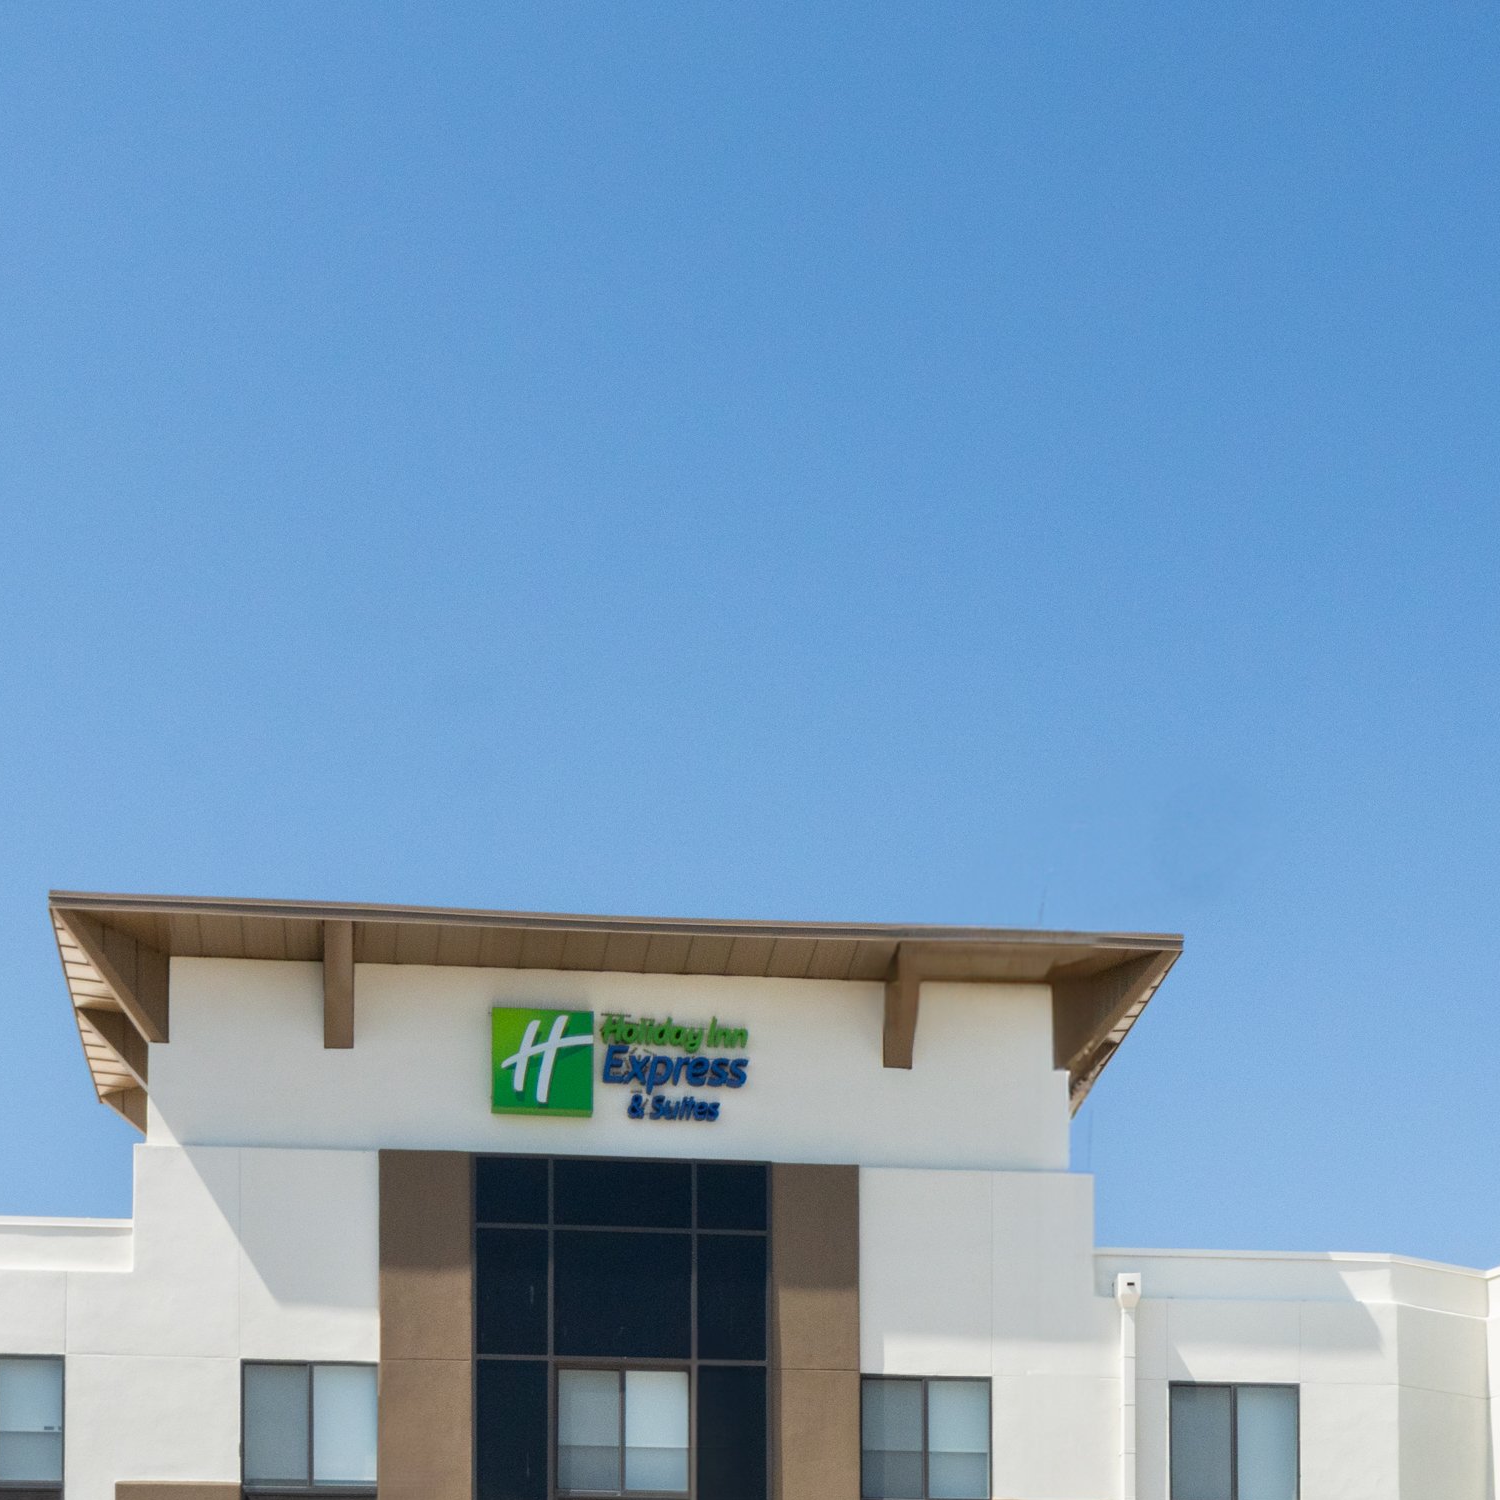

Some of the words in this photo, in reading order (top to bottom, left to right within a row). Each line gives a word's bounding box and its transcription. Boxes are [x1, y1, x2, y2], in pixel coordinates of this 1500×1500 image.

[601, 1014, 704, 1053] Holiday
[706, 1016, 749, 1048] Inn
[602, 1044, 749, 1094] Express
[627, 1094, 644, 1119] &
[649, 1095, 720, 1121] Suites
